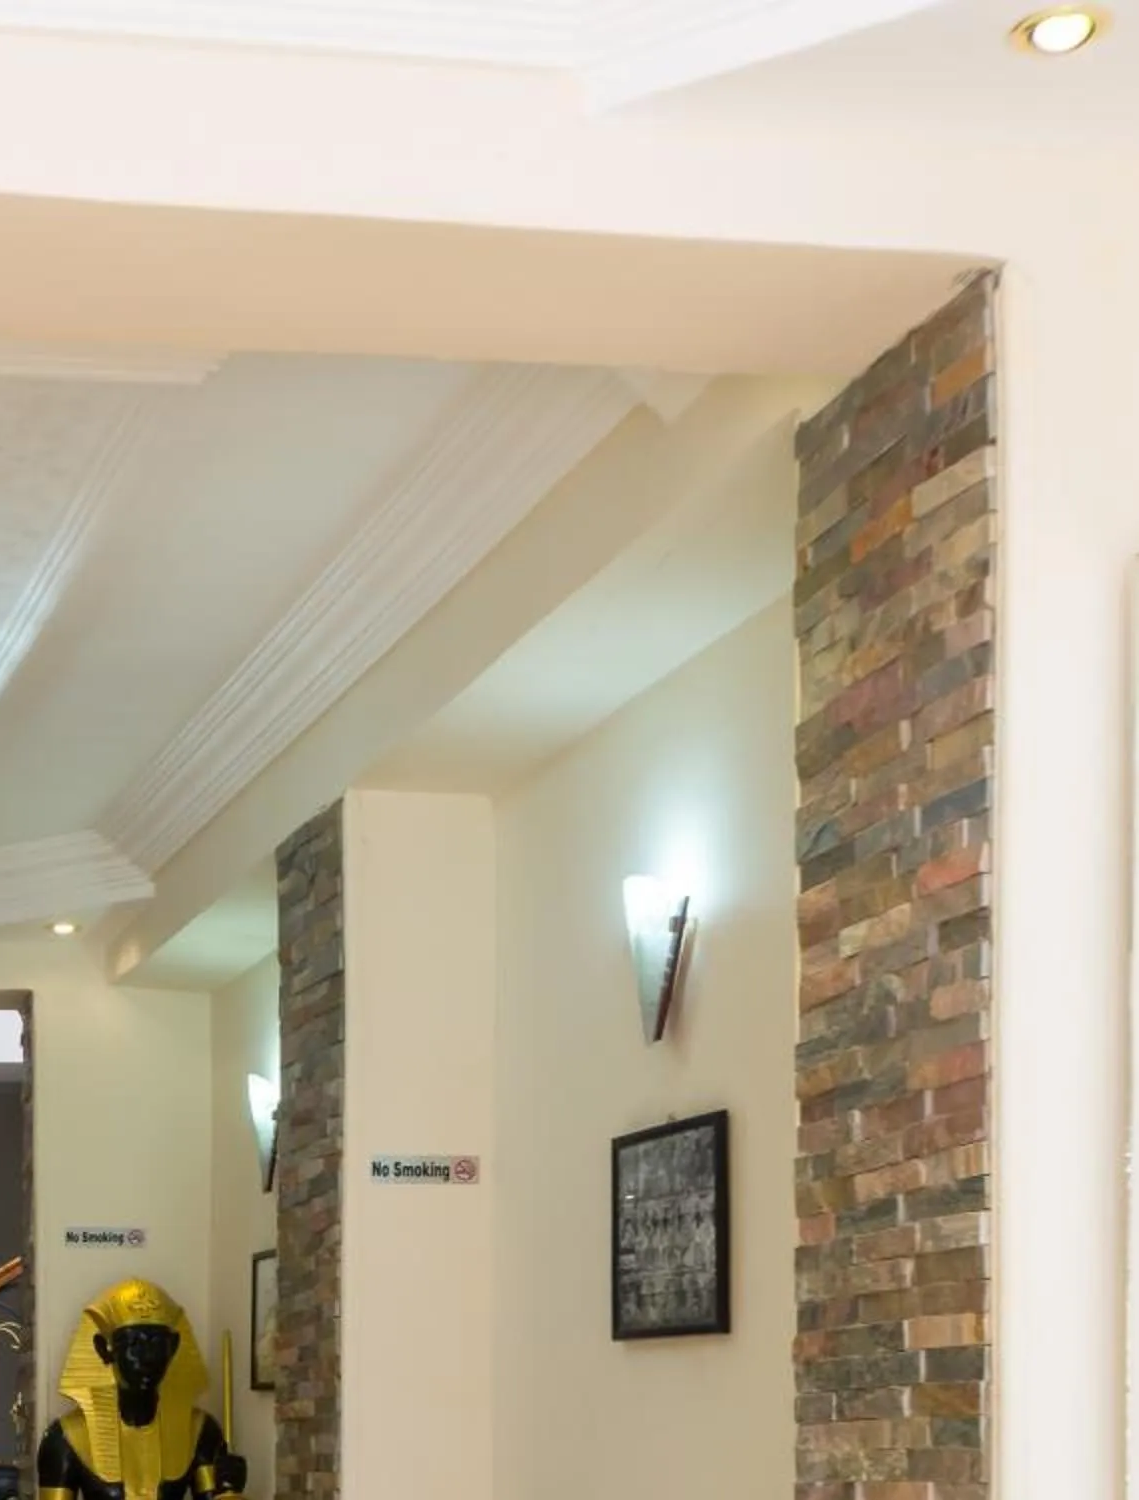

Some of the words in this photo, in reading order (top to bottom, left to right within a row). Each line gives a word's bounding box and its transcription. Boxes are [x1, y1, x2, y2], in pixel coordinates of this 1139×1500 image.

[370, 1161, 389, 1177] No
[393, 1161, 449, 1182] Smoking
[66, 1231, 79, 1243] No
[82, 1231, 124, 1247] Smoking
